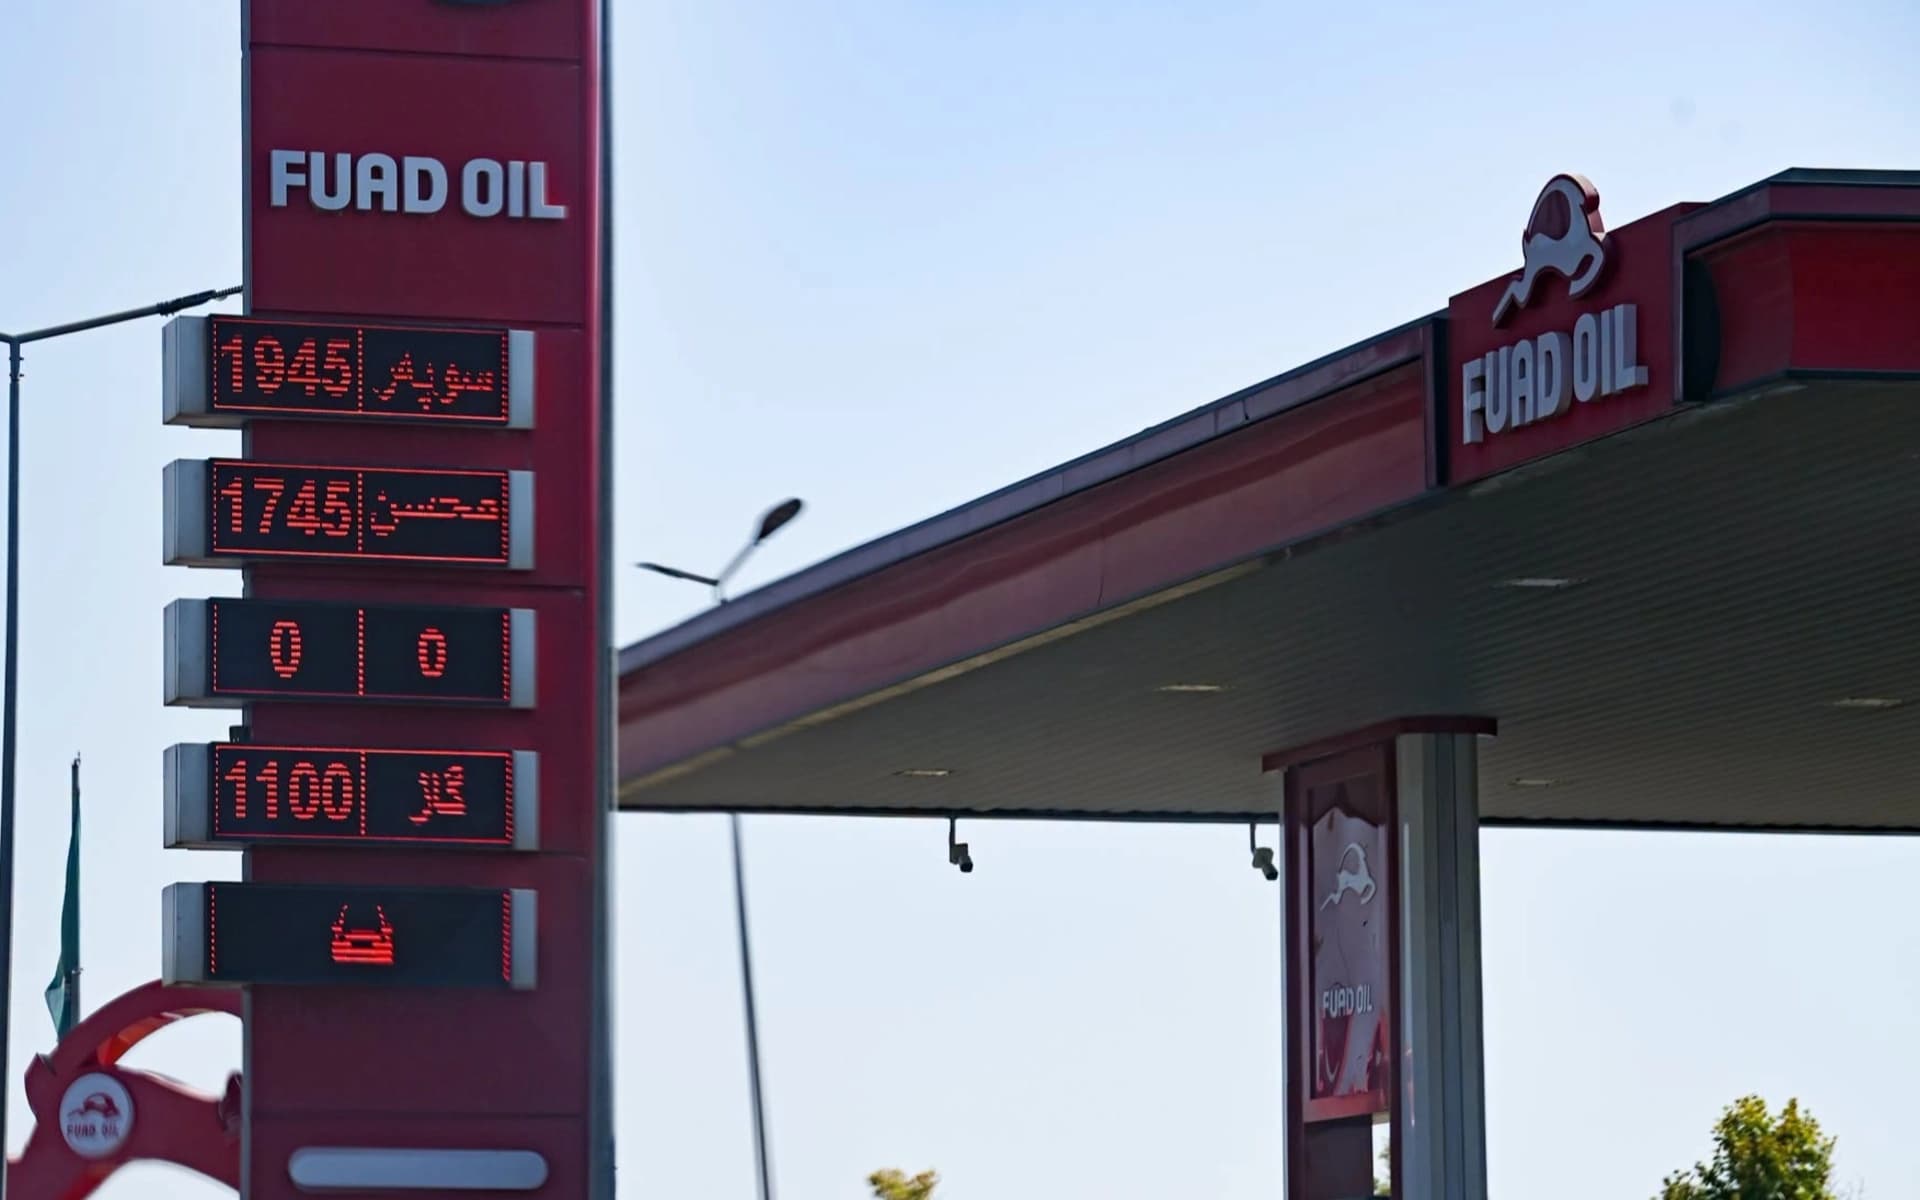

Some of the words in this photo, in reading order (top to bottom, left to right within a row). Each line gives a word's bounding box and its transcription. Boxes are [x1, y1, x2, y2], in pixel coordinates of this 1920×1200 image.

[270, 149, 448, 214] FUAD
[461, 157, 567, 219] OIL
[220, 331, 353, 398] 1945
[1462, 331, 1571, 445] FUAD
[1573, 304, 1648, 402] OIL
[220, 476, 353, 537] 1745
[270, 620, 302, 679] 0
[224, 759, 354, 821] 1100
[1321, 987, 1354, 1018] FUAD
[1356, 984, 1373, 1015] OIL
